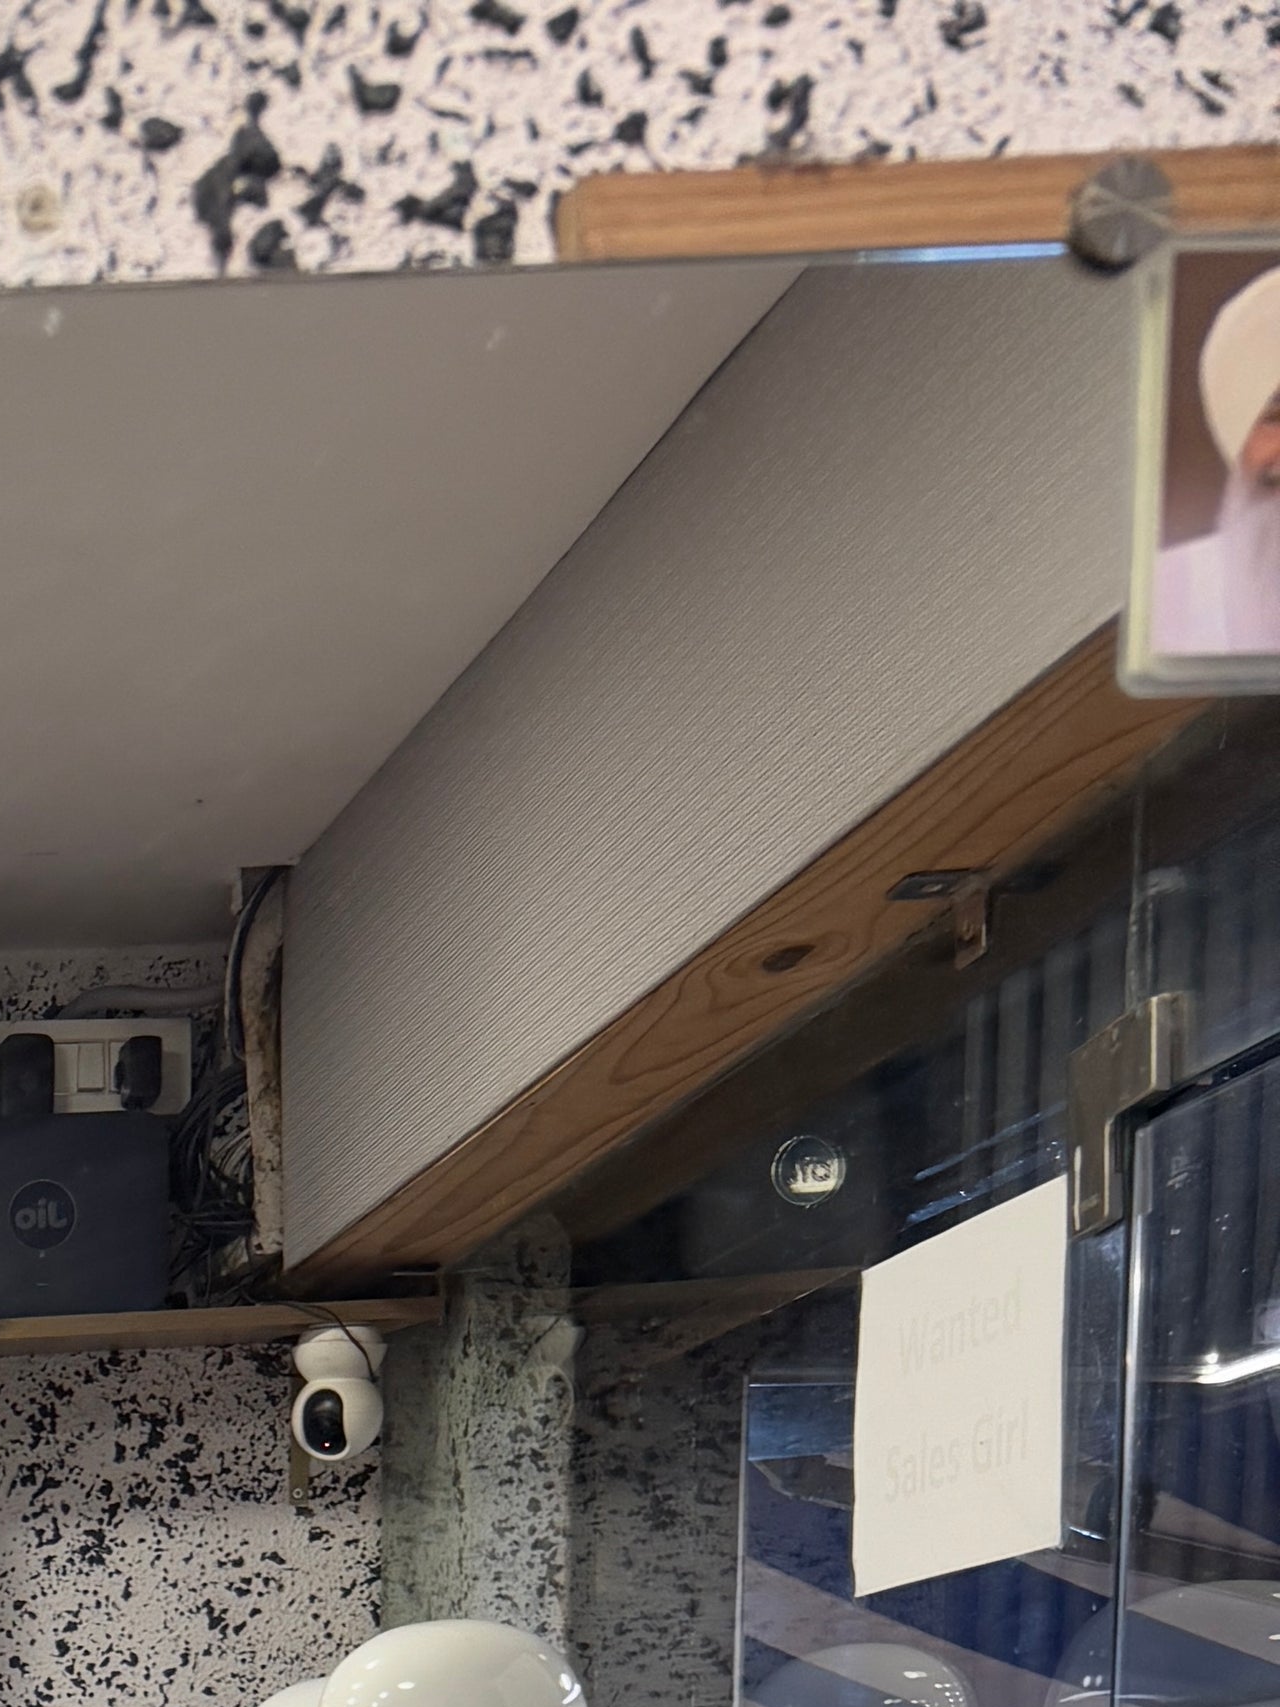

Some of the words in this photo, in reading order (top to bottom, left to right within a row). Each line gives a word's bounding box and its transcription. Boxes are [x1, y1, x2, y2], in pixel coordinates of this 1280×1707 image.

[897, 1265, 1024, 1380] Wanted
[885, 1428, 961, 1505] Sales
[972, 1395, 1030, 1475] Girl
